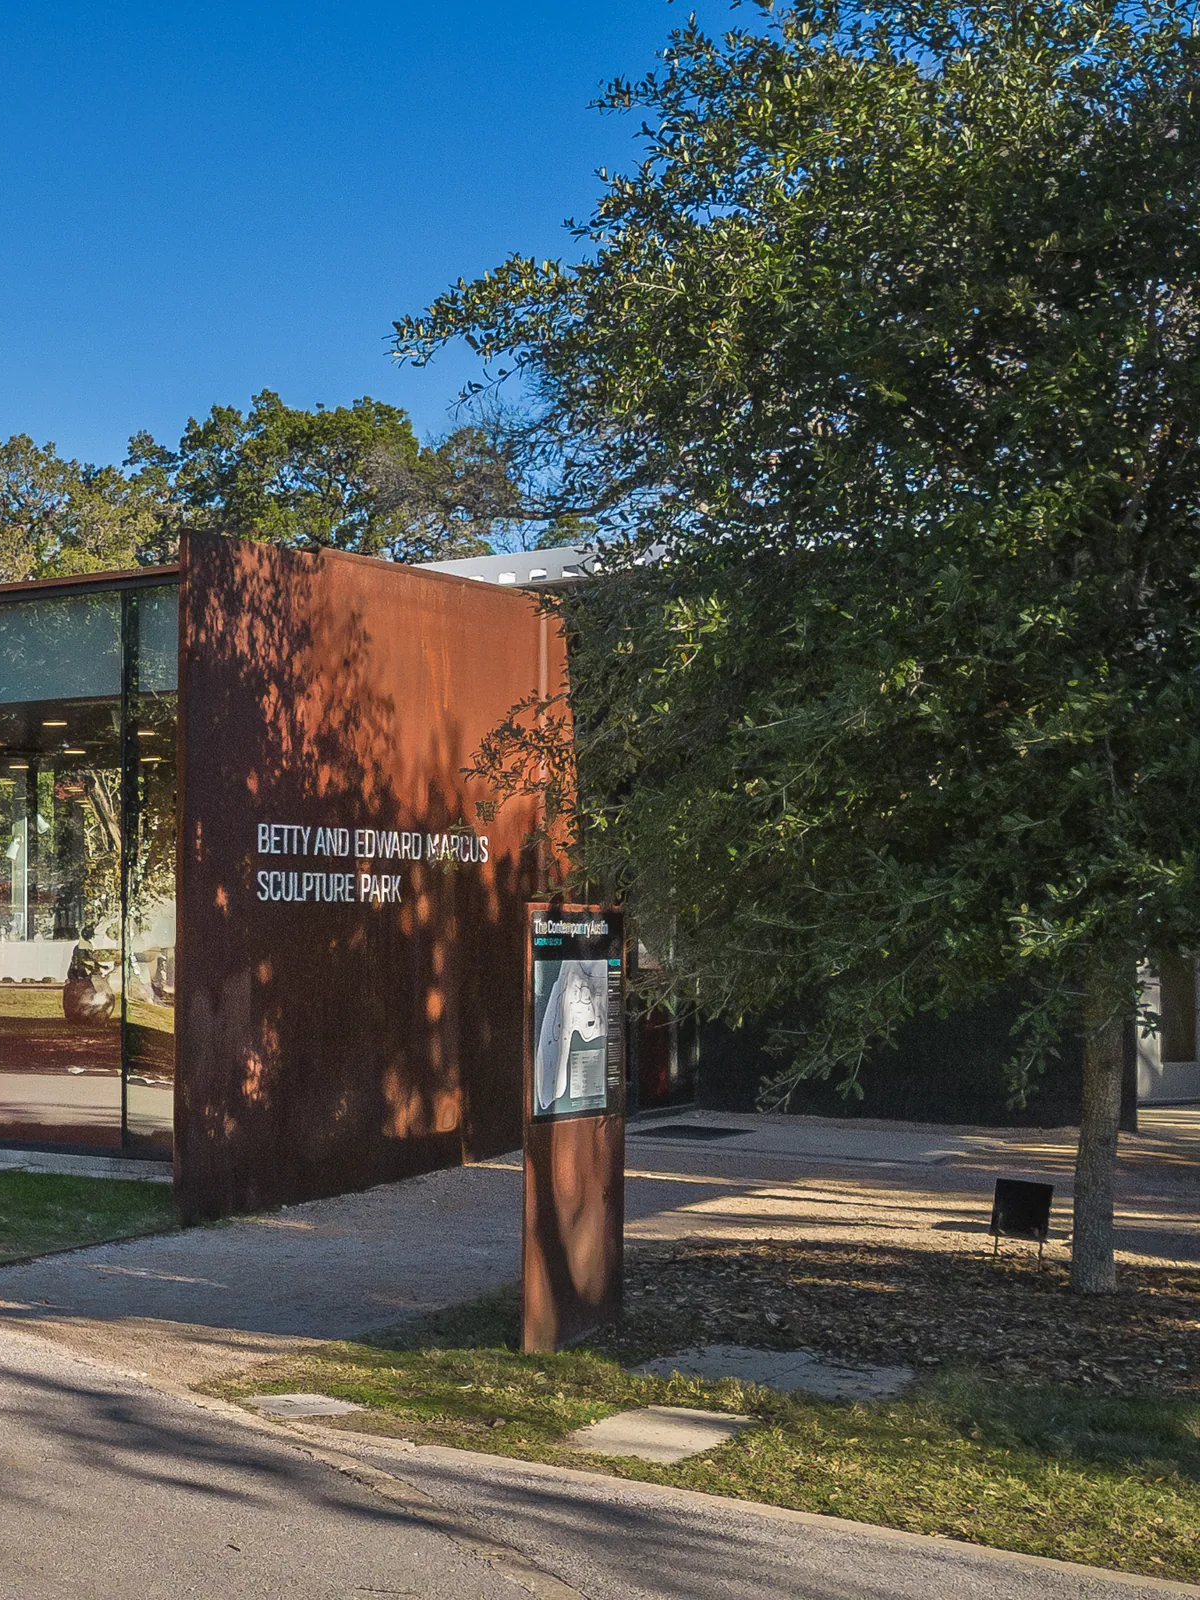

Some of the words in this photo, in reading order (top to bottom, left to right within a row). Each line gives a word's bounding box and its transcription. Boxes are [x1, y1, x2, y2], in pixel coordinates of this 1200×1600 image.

[257, 823, 310, 855] BETTY
[313, 827, 349, 857] AND
[355, 829, 422, 860] EDWARD
[426, 833, 489, 864] MARCUS
[257, 871, 355, 902] SCULPTURE
[359, 873, 402, 903] PARK
[534, 919, 547, 934] The
